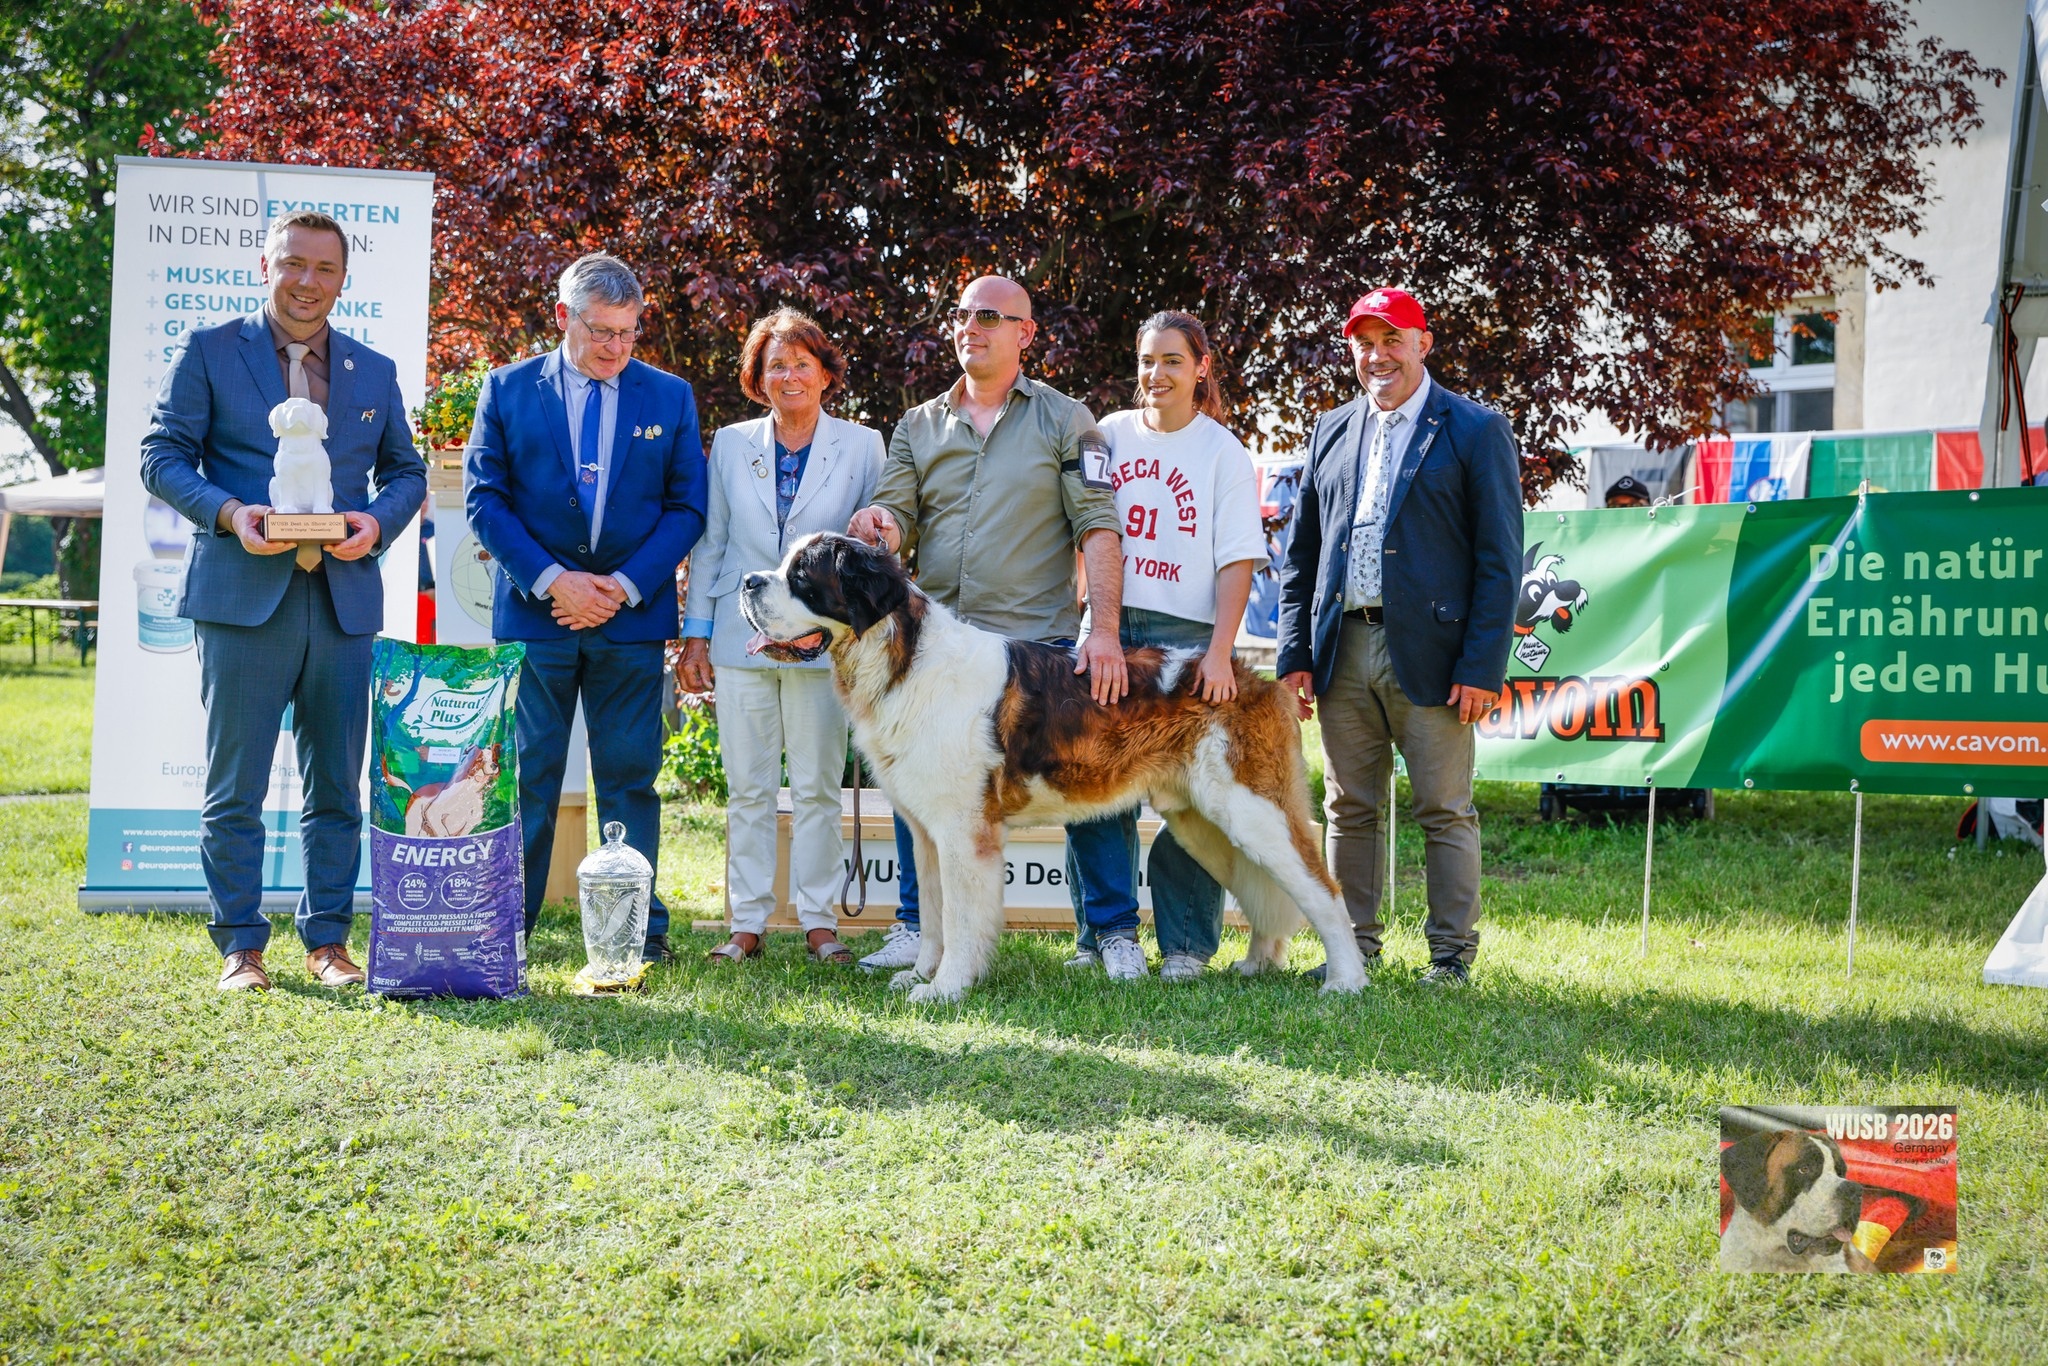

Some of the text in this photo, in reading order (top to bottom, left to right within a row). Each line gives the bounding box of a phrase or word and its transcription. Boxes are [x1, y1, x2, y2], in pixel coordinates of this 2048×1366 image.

[148, 193, 194, 214] WIR
[202, 196, 259, 217] SIND
[149, 224, 172, 244] IN
[182, 226, 230, 247] DEN
[165, 293, 269, 313] GESUND
[1111, 458, 1197, 538] BECA WEST
[1125, 504, 1159, 541] 91
[1134, 556, 1182, 582] YORK
[1809, 537, 2043, 583] Die natür
[1807, 594, 2048, 637] Ernährun
[1829, 651, 1972, 703] jeden
[431, 696, 481, 709] Natural
[1475, 675, 1666, 743] avom
[430, 710, 462, 723] Plus
[1879, 732, 2047, 753] www.cavom.
[161, 762, 207, 779] Europ
[391, 839, 494, 867] ENERGY
[404, 878, 471, 888] 24% 18%
